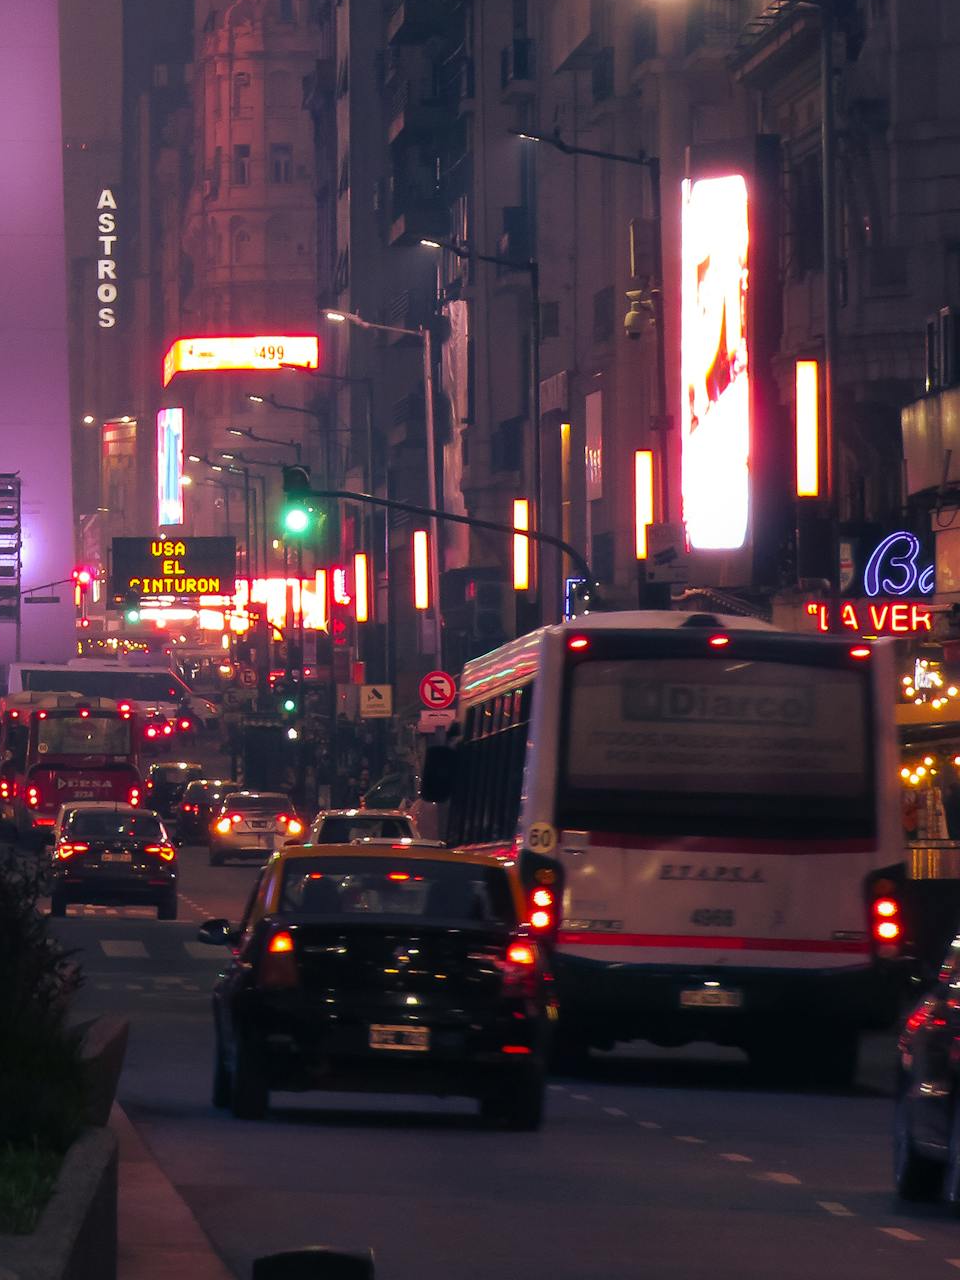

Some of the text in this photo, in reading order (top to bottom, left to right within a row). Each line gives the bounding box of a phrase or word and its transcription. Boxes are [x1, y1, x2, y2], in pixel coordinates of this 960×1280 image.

[97, 189, 117, 328] ASTROS
[151, 541, 186, 557] USA
[162, 560, 186, 575] EL
